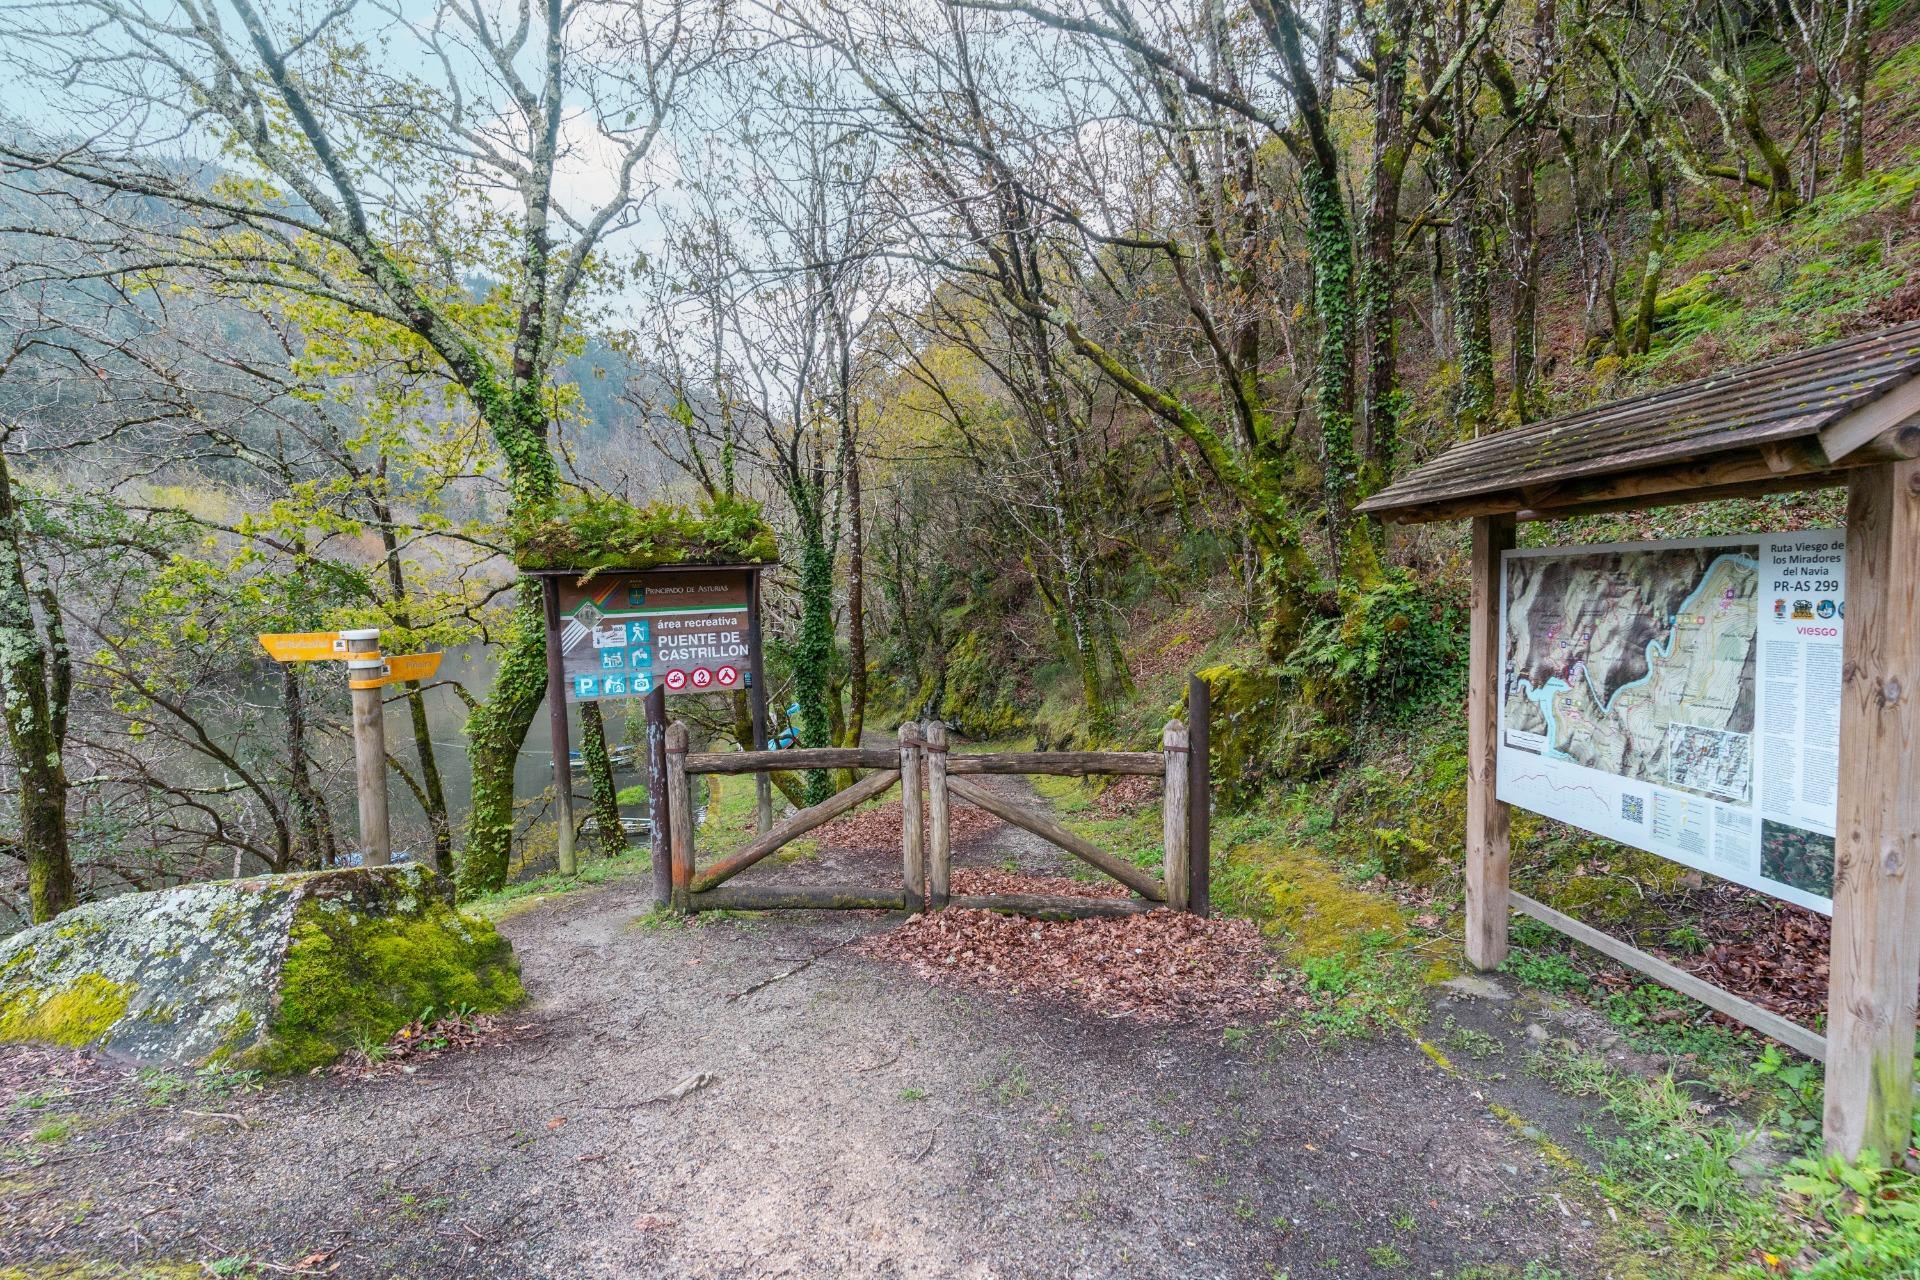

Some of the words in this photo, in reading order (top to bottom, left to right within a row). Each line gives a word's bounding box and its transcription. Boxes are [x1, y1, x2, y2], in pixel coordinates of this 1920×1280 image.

[1770, 544, 1793, 553] Ruta
[1794, 542, 1829, 553] Viesgo
[1831, 540, 1845, 550] de
[1773, 555, 1787, 565] los
[1789, 554, 1841, 565] Miradores
[1783, 567, 1798, 576] del
[1800, 566, 1829, 576] Navia
[645, 587, 684, 595] PRINCIPADO
[698, 584, 728, 593] ASTURIAS
[1774, 580, 1811, 592] PR-AS
[1815, 580, 1839, 592] 299
[658, 619, 681, 629] área
[684, 616, 737, 628] recreativa
[658, 633, 717, 648] PUENTE
[720, 631, 740, 644] DE
[659, 644, 749, 661] CASTRILLON
[580, 678, 593, 694] P
